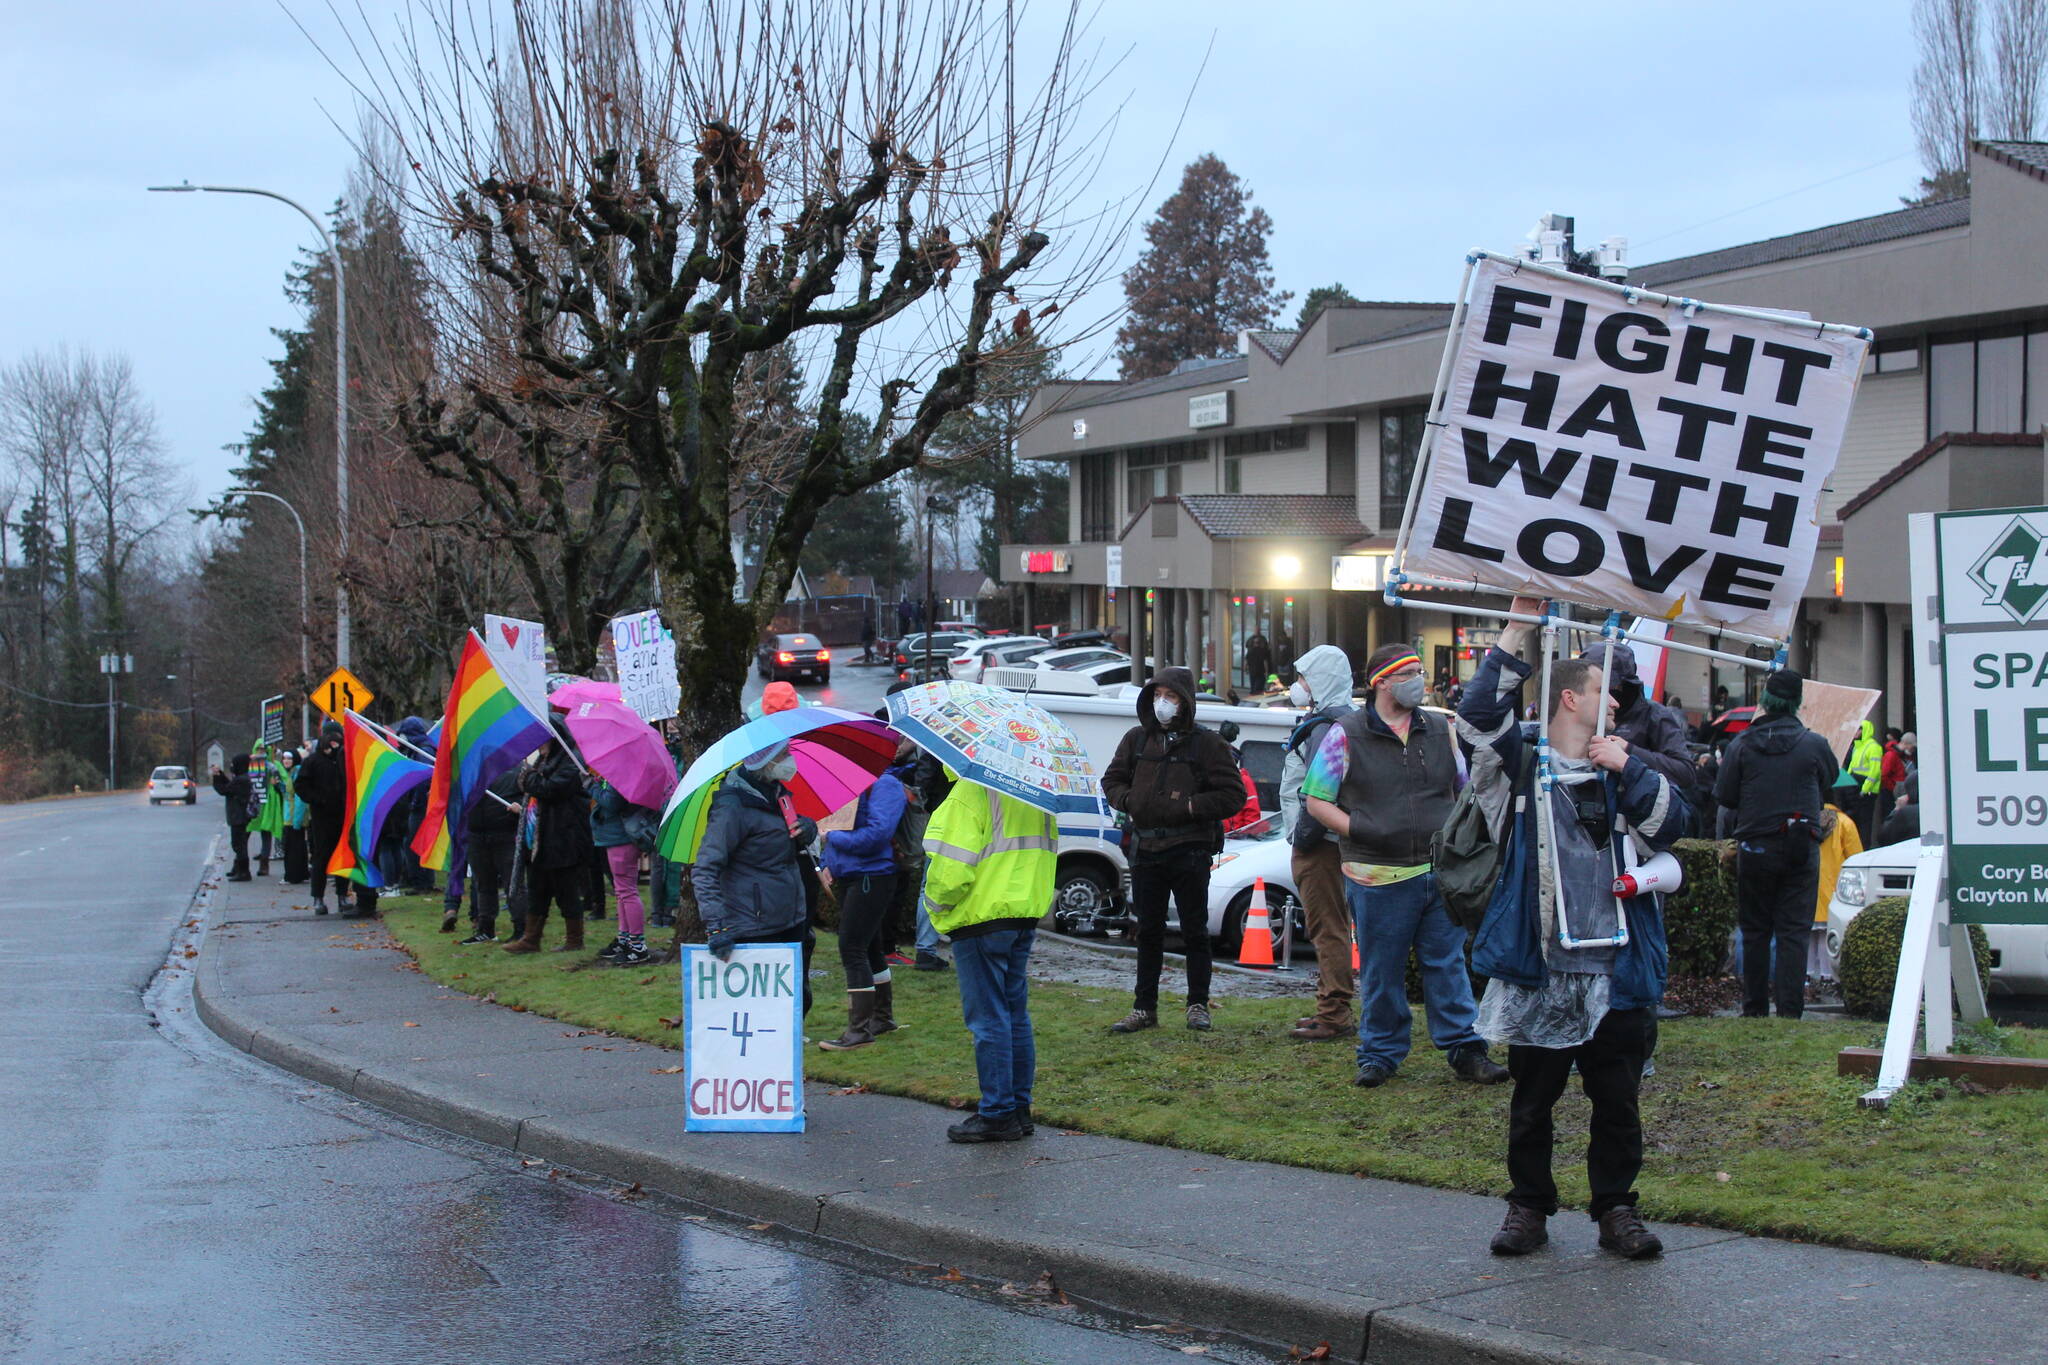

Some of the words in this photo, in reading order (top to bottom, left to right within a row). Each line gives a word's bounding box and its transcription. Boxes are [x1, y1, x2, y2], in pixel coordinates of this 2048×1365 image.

[1483, 285, 1832, 406] FIGHT
[1467, 360, 1813, 483] HATE
[1461, 427, 1799, 548] WITH
[1432, 497, 1784, 610] LOVE
[633, 647, 659, 669] and
[1974, 707, 2048, 772] LE
[983, 768, 997, 780] The
[997, 774, 1020, 790] Seattle
[1019, 783, 1041, 797] Times
[1977, 795, 2048, 826] 509
[1981, 864, 2025, 883] Cory
[1956, 887, 2028, 906] Clayton
[698, 960, 794, 1000] HONK
[690, 1078, 794, 1116] CHOICE
